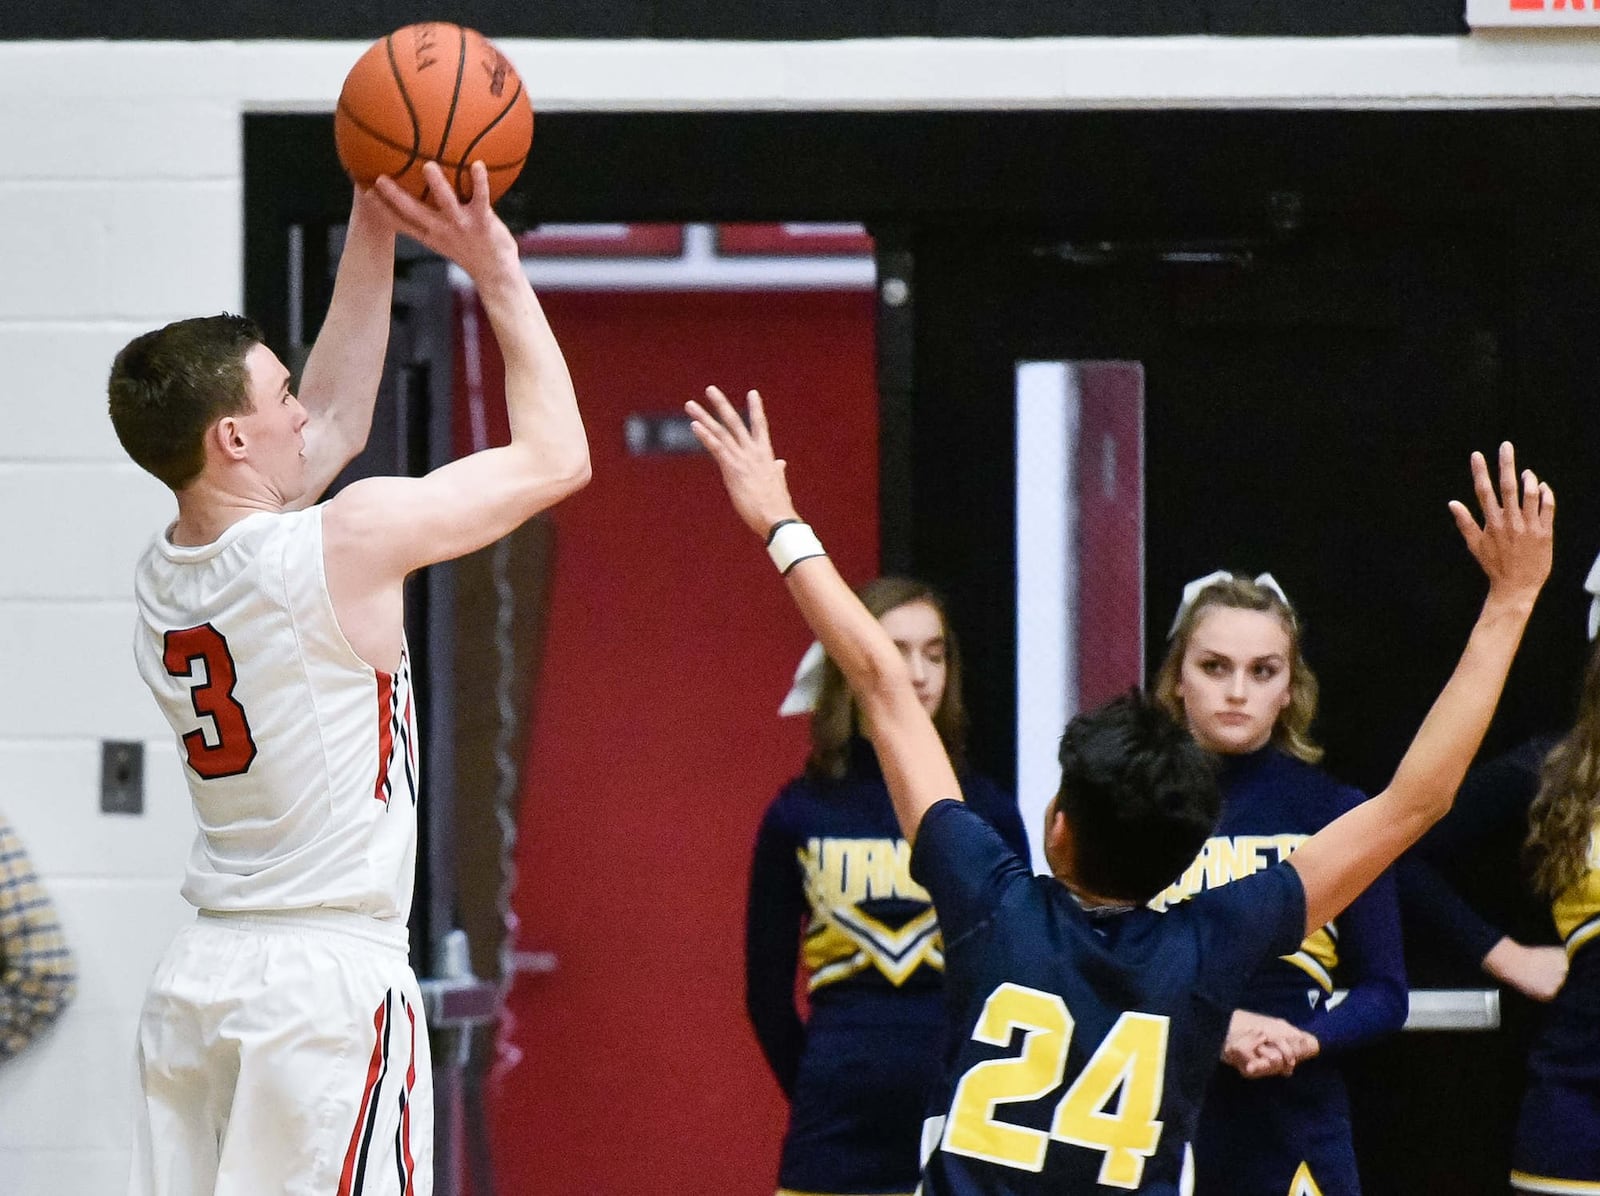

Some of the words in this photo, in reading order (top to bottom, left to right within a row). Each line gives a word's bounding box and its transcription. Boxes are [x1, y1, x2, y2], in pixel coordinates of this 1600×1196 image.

[162, 621, 258, 781] 3
[803, 837, 932, 900] HORN
[1146, 834, 1309, 914] RNET
[940, 981, 1170, 1190] 24
